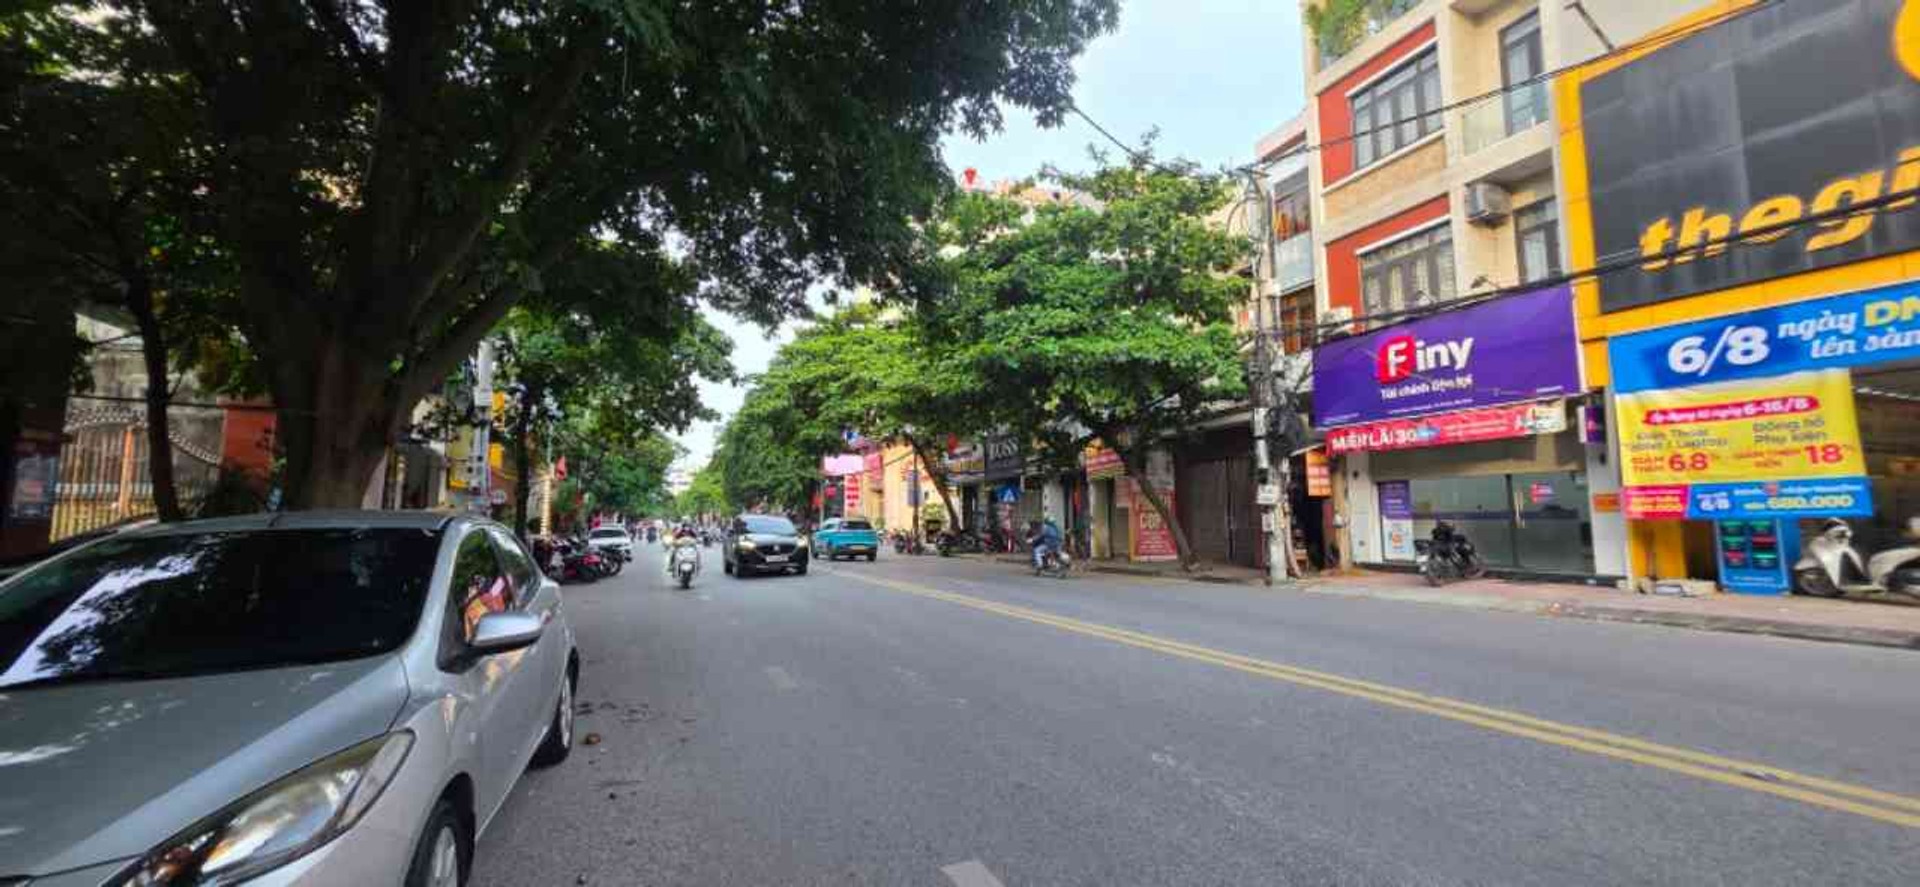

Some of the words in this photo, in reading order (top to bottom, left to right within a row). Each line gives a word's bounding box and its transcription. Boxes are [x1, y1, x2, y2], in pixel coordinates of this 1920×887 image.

[1778, 309, 1858, 341] ngày
[1387, 337, 1474, 378] Finy
[1668, 325, 1770, 377] 6/8
[1804, 443, 1844, 465] 18
